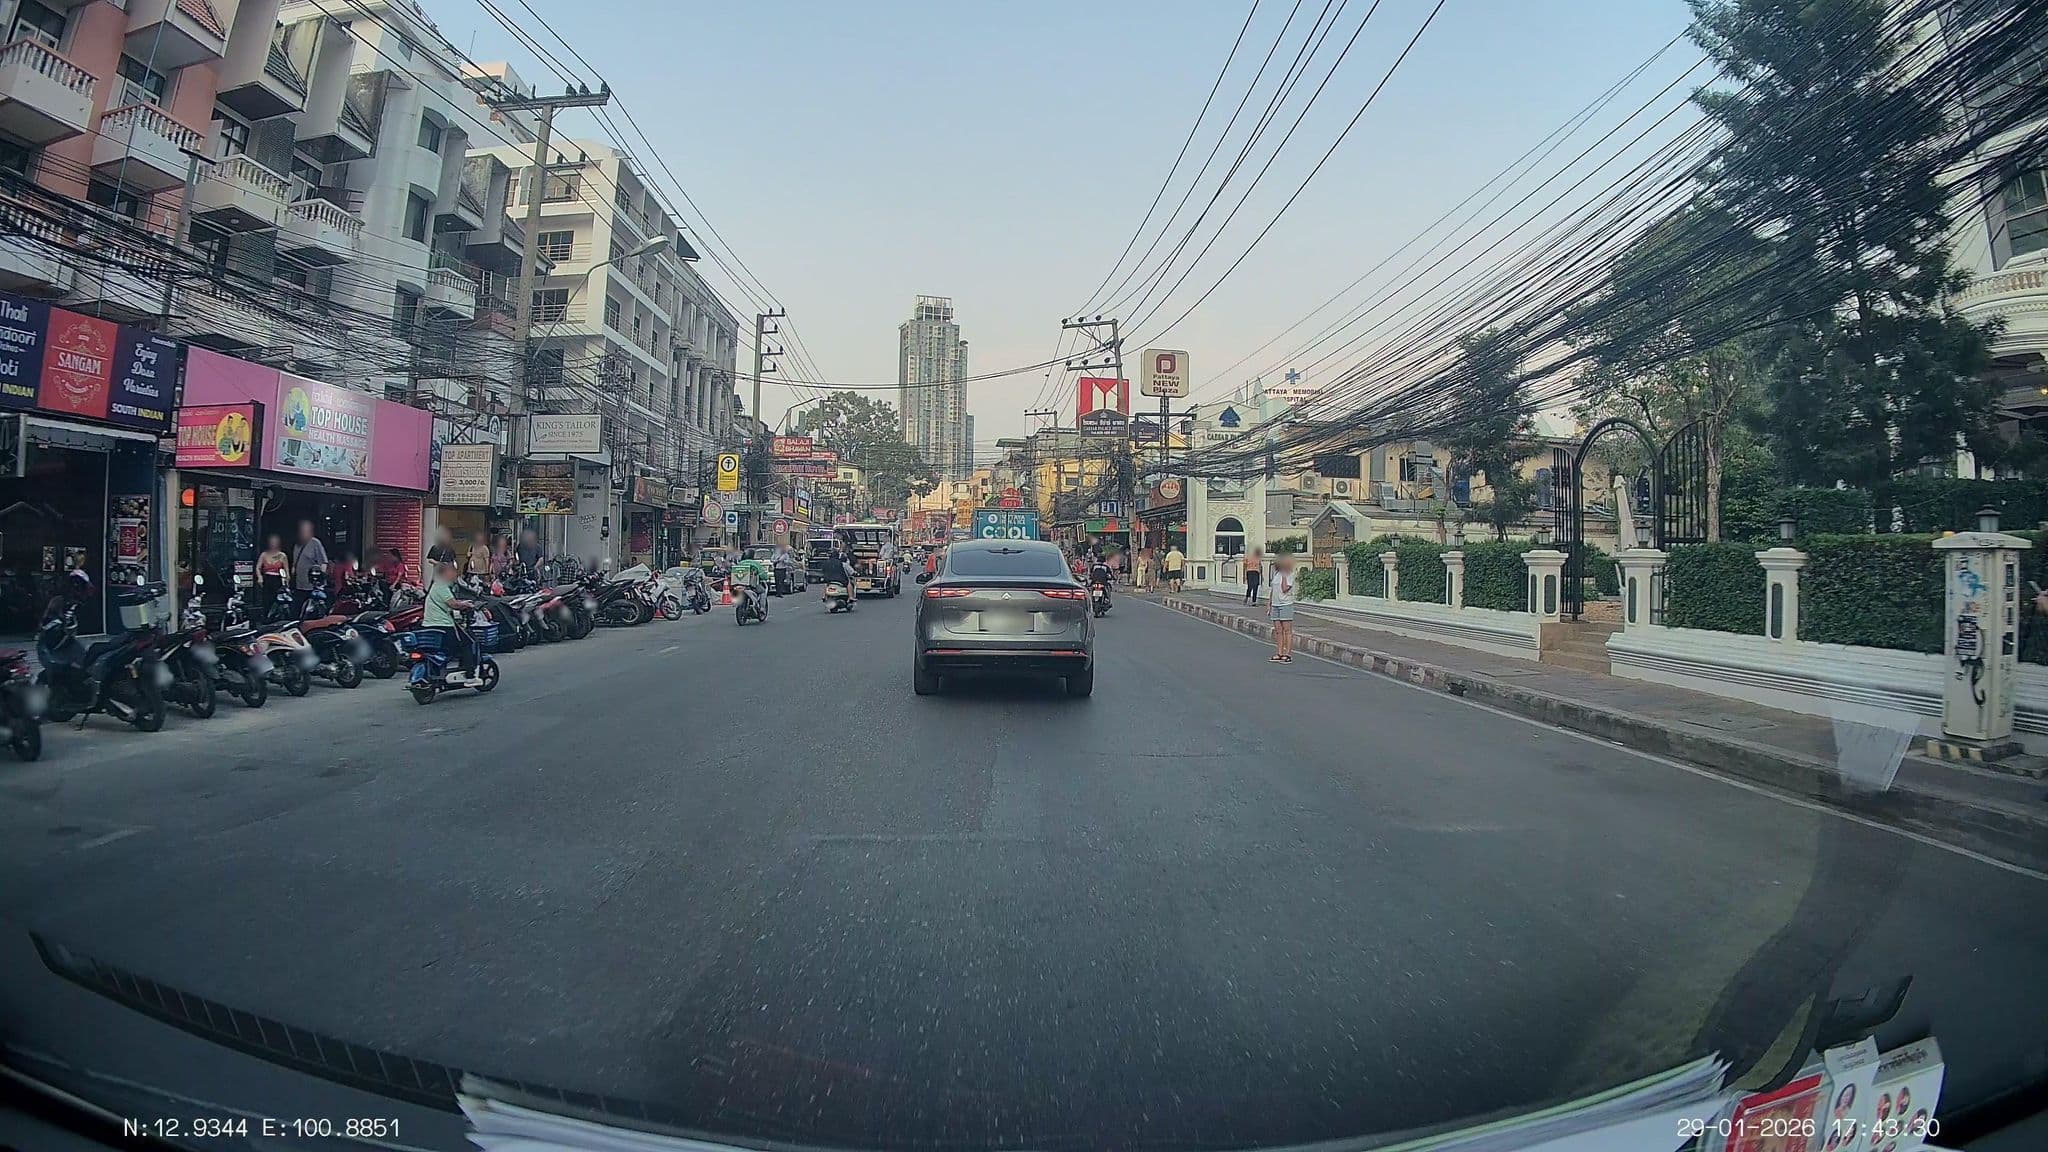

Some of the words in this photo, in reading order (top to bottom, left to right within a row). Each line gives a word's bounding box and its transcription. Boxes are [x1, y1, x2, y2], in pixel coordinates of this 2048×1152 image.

[58, 352, 102, 375] SANGAM
[2, 383, 35, 398] INDIAN
[111, 403, 137, 416] SOUTH
[137, 408, 165, 421] INDIAN
[312, 406, 331, 427] TOP
[334, 411, 368, 436] HOUSE
[536, 421, 563, 429] KING'S
[565, 421, 596, 429] TAILOR
[178, 426, 192, 447] TOP
[192, 425, 217, 446] HOUSE
[309, 429, 335, 443] HEALTH
[983, 525, 1031, 540] COOL
